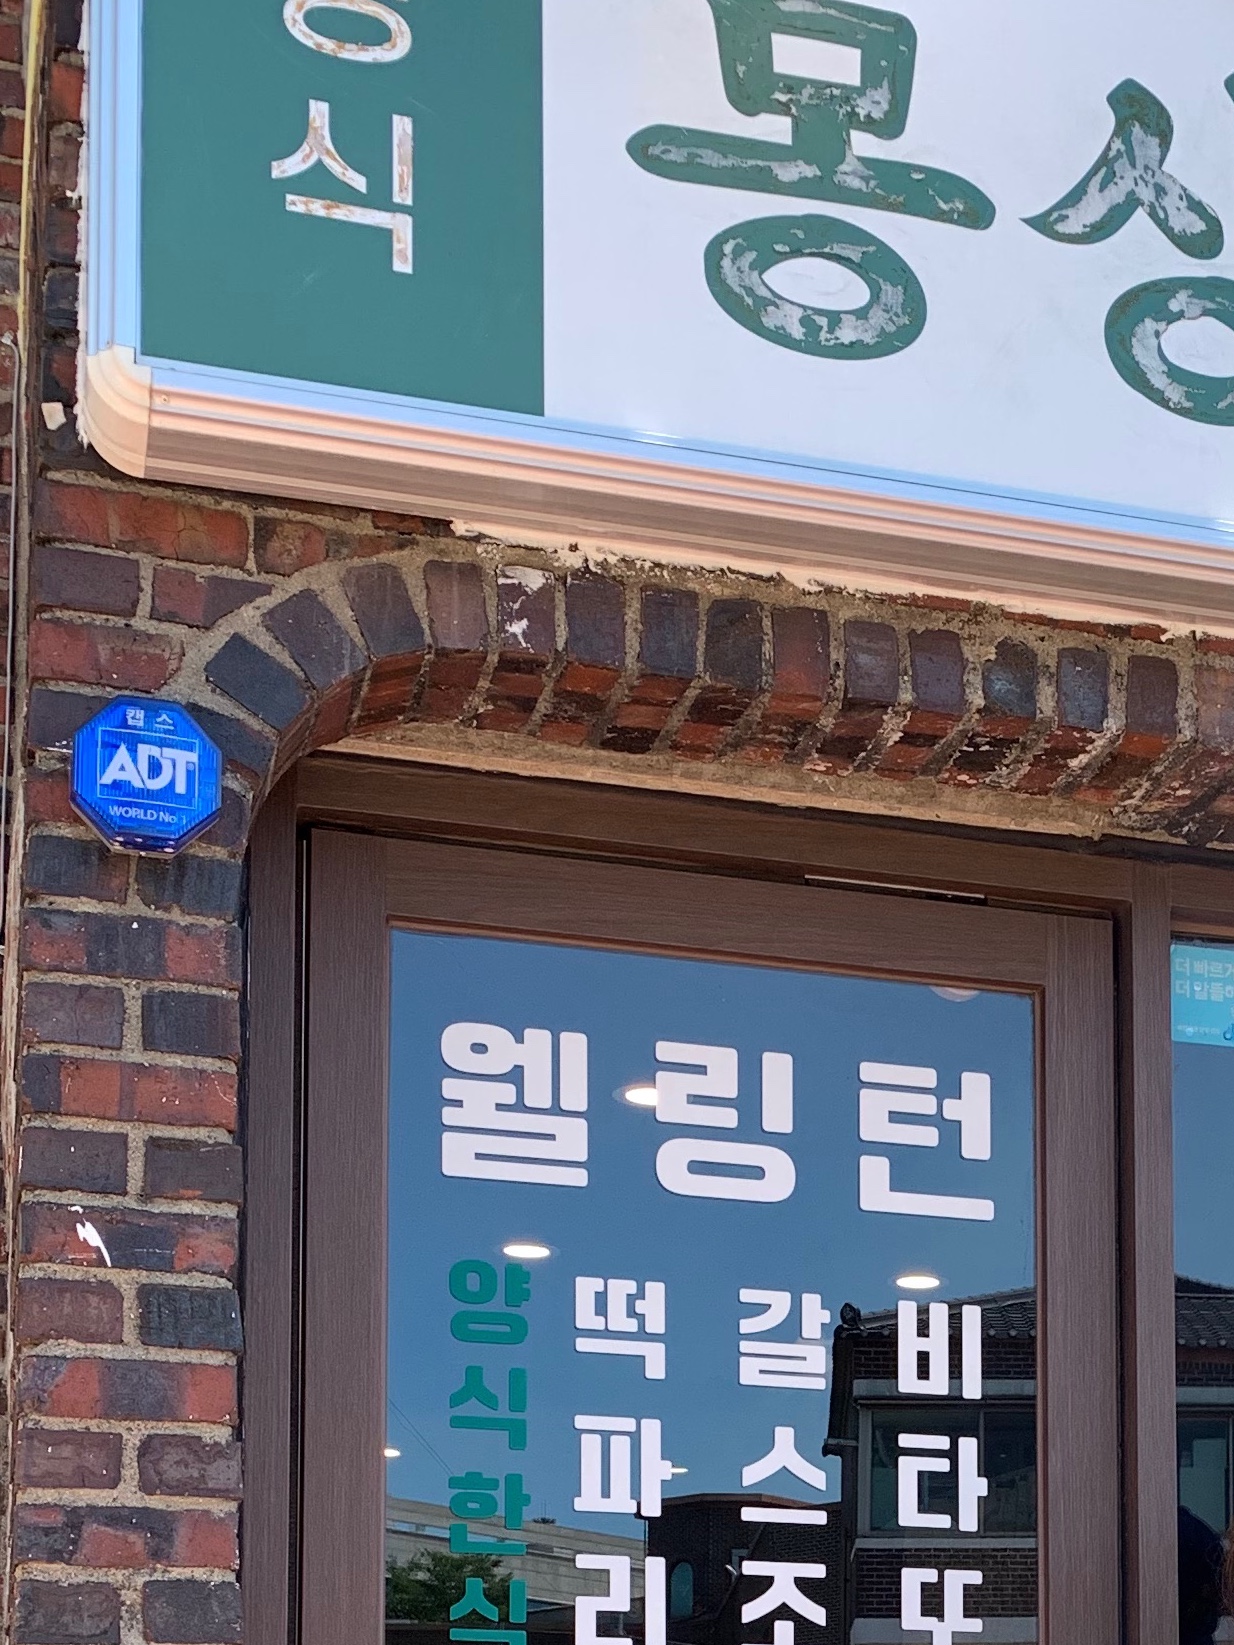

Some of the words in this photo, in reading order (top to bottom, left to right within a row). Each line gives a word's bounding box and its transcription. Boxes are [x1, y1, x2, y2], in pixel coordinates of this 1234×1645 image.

[126, 708, 175, 730] 캡스
[99, 740, 198, 795] ADT
[108, 804, 157, 821] WORLD
[1174, 958, 1191, 977] 더
[1174, 980, 1191, 998] 더
